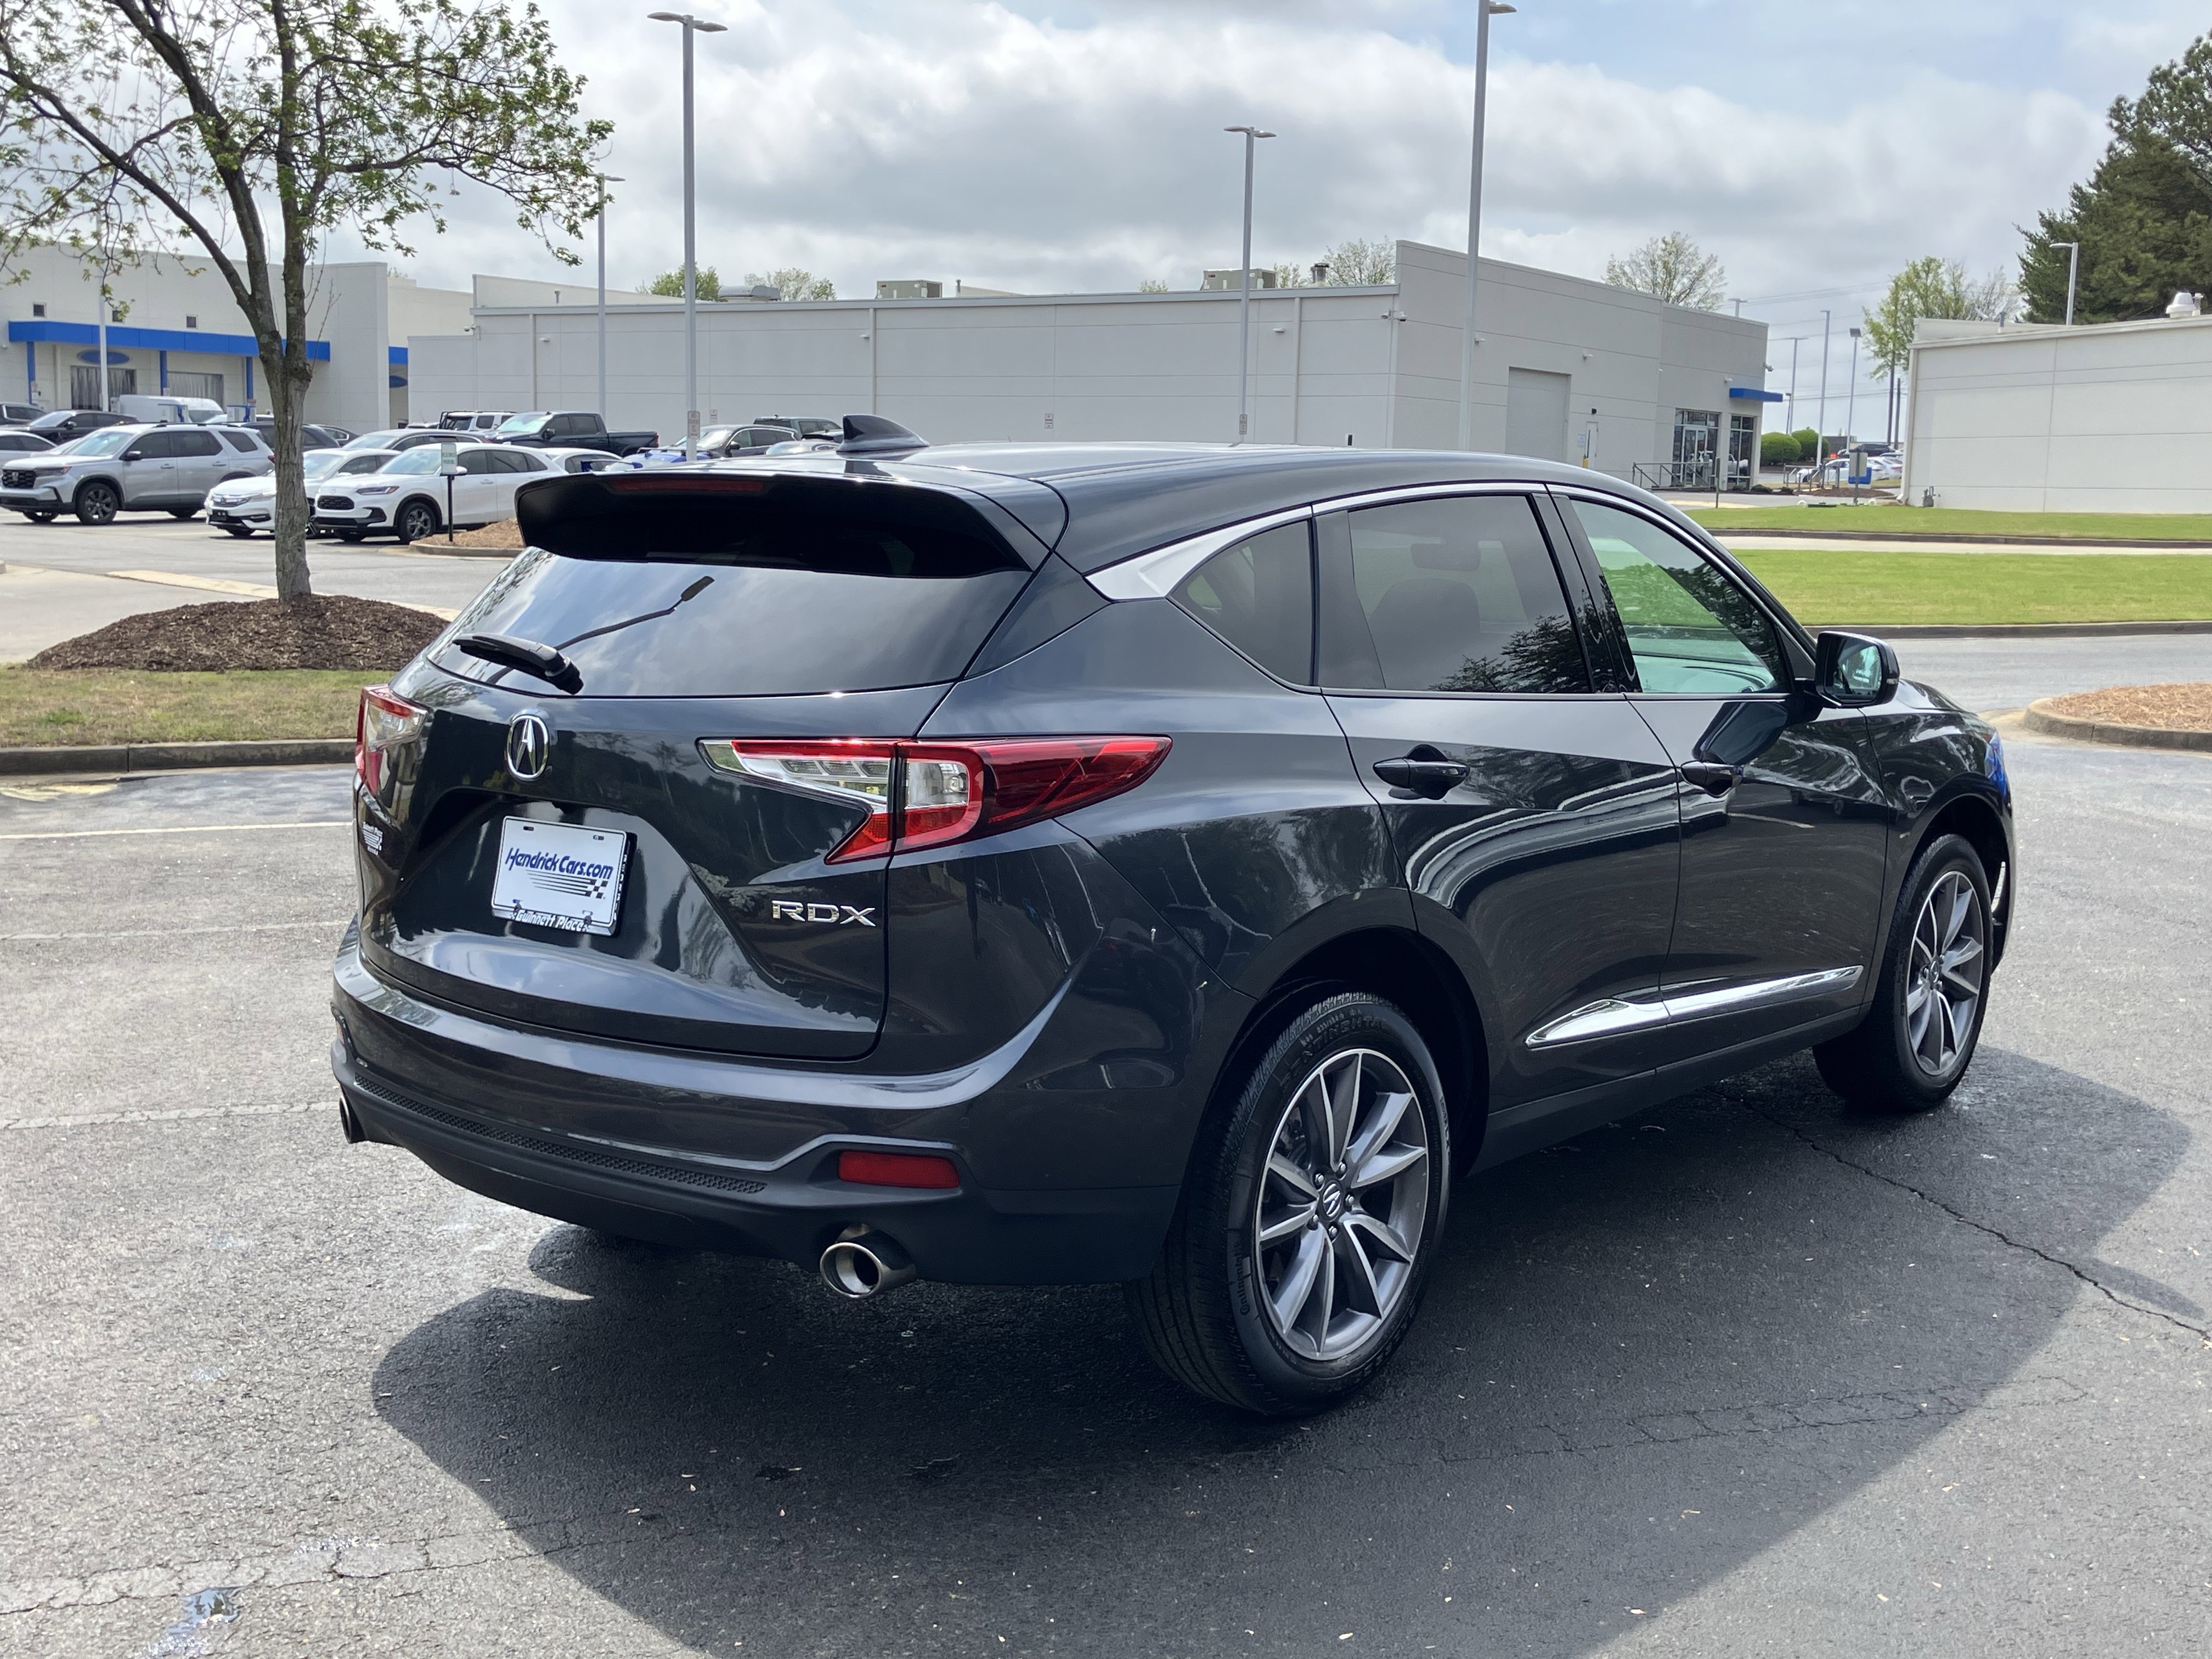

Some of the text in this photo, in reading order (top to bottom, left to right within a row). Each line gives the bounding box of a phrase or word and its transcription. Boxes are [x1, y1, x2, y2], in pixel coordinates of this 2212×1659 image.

[515, 909, 584, 932] Gwinnett Place
[772, 900, 876, 927] RDX
